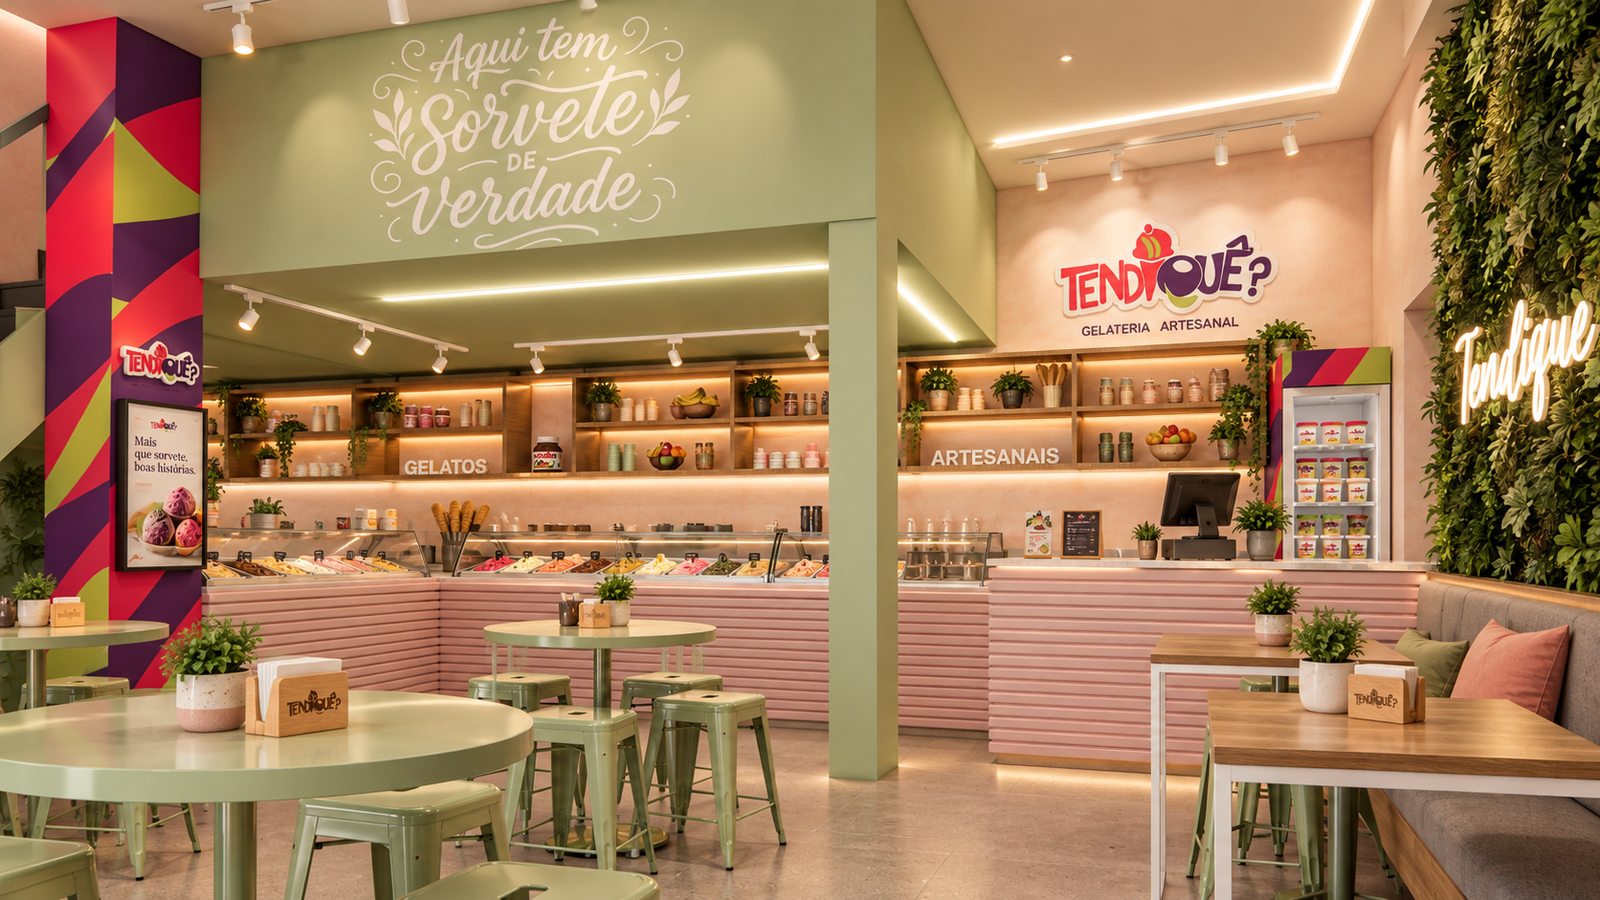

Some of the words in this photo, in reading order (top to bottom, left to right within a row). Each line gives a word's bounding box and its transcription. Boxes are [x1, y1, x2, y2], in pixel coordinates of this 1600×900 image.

[429, 26, 529, 89] Aqui
[536, 18, 618, 61] tem
[412, 65, 648, 176] Sorvete
[507, 151, 537, 172] DE
[386, 157, 642, 235] Verdade
[1081, 322, 1150, 337] GELATERIA
[1160, 317, 1239, 332] ARTESANAL
[1454, 299, 1600, 425] Tendique
[134, 435, 157, 447] Mais
[134, 450, 152, 461] que
[153, 452, 188, 463] sorvete,
[930, 447, 1060, 467] ARTESANAIS
[134, 460, 156, 472] boas
[157, 462, 196, 475] histórias.
[404, 458, 487, 476] GELATOS
